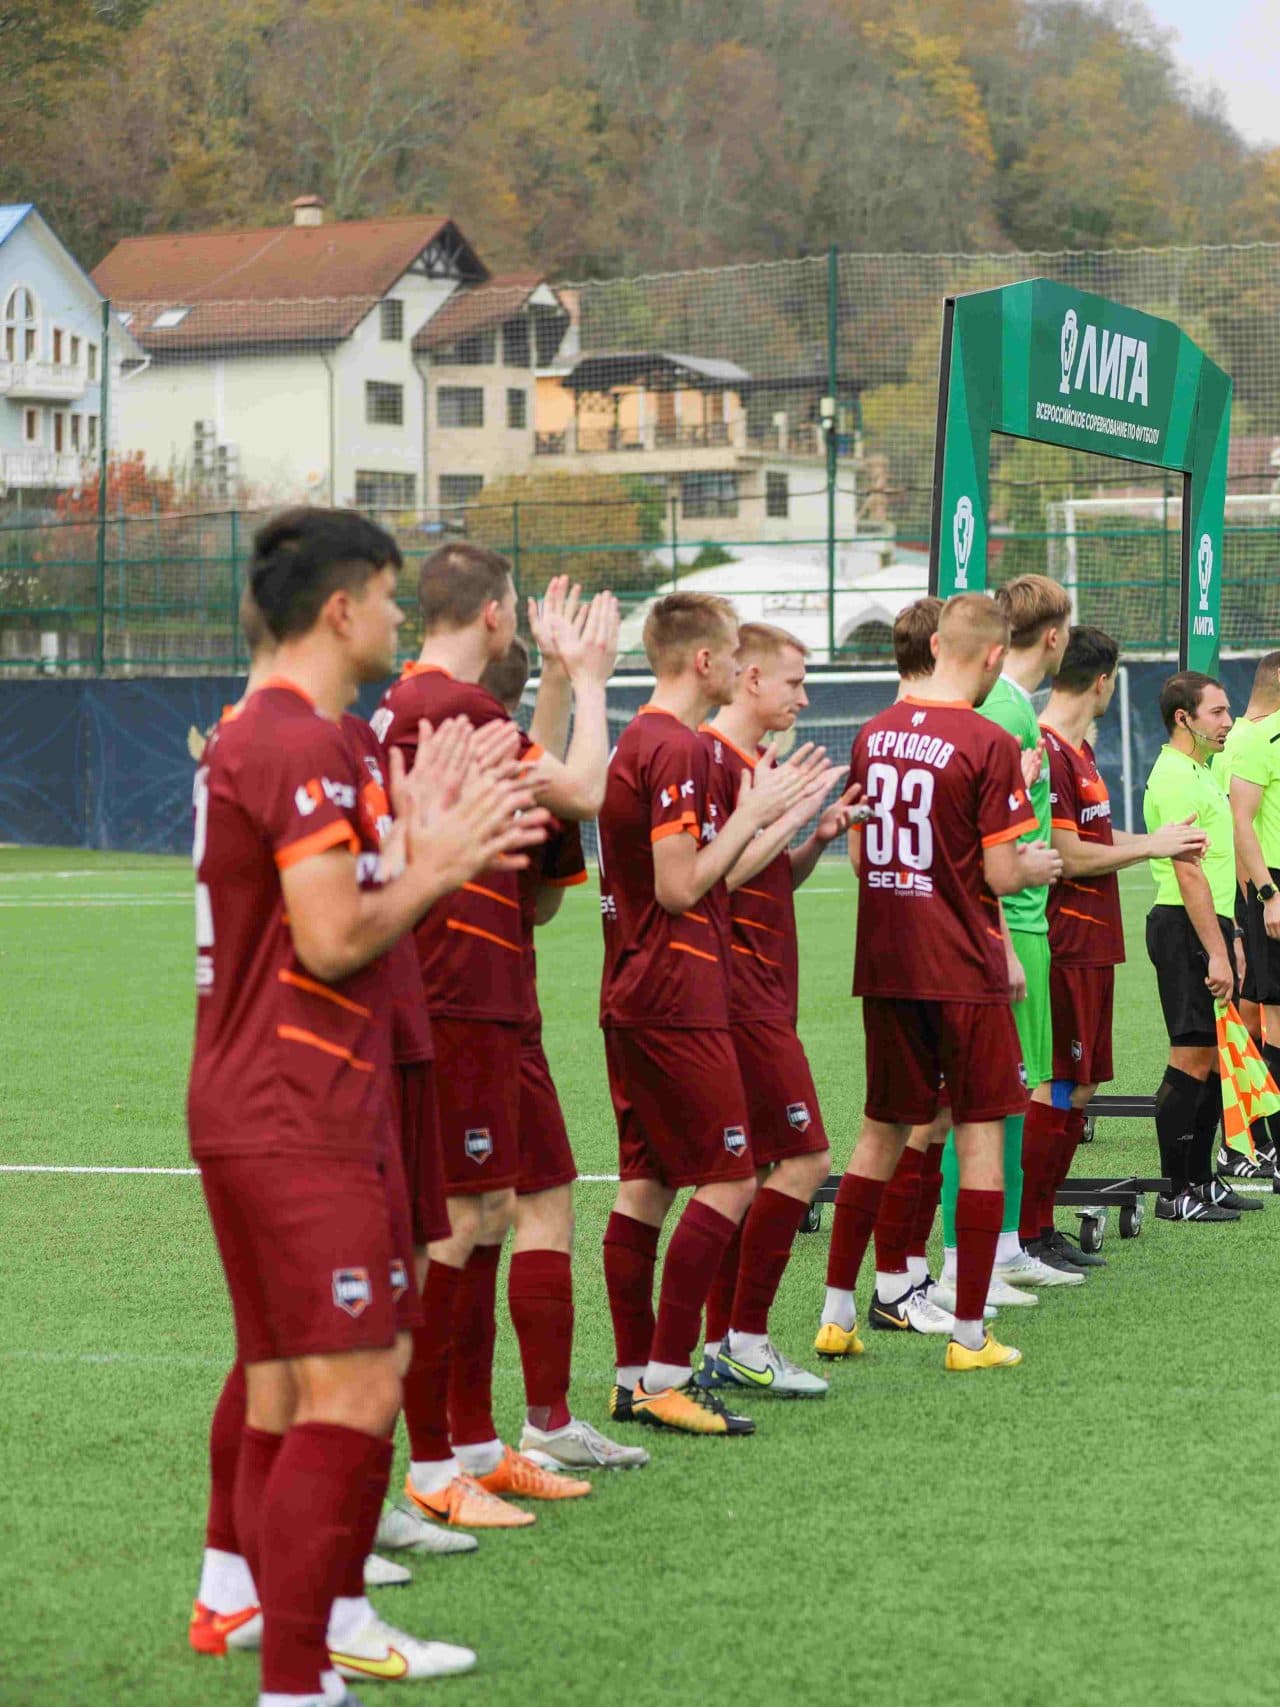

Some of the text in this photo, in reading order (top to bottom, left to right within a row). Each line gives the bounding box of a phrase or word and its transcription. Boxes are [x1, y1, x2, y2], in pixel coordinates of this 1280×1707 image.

[1074, 324, 1148, 407] ЛИГА
[1036, 401, 1160, 445] ВСЕРОССИЙСКОЕ СОРЕВНОВАНИЕ ПО ФУТБОЛУ
[1193, 616, 1214, 636] ЛИГА
[867, 731, 955, 769] ЧЕРКАСОВ
[866, 763, 935, 870] 33
[868, 871, 933, 892] SEUS
